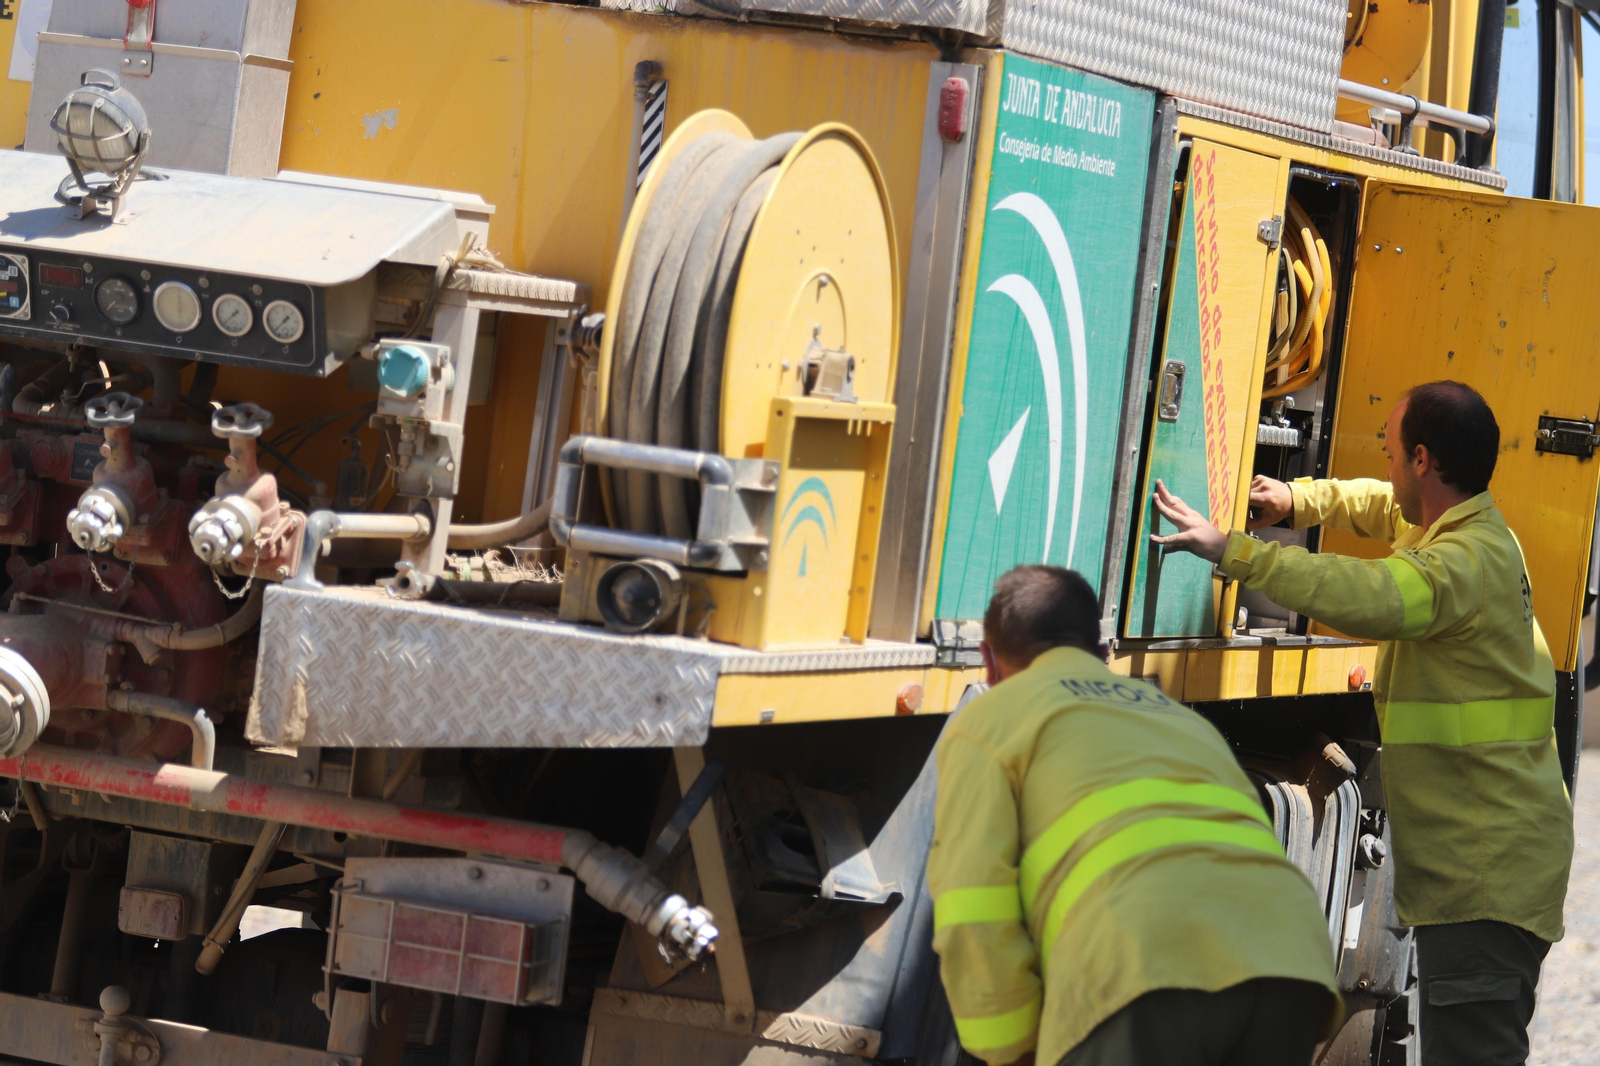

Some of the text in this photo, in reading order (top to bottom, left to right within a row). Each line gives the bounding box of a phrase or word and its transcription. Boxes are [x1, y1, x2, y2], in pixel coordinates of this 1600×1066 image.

[1003, 73, 1041, 119] JUNTA
[1043, 84, 1062, 124] DE
[1041, 142, 1052, 163] de
[1052, 144, 1078, 169] Medio
[1078, 150, 1116, 177] Ambiente
[1193, 153, 1220, 532] de incendios forestale
[1212, 304, 1222, 350] de
